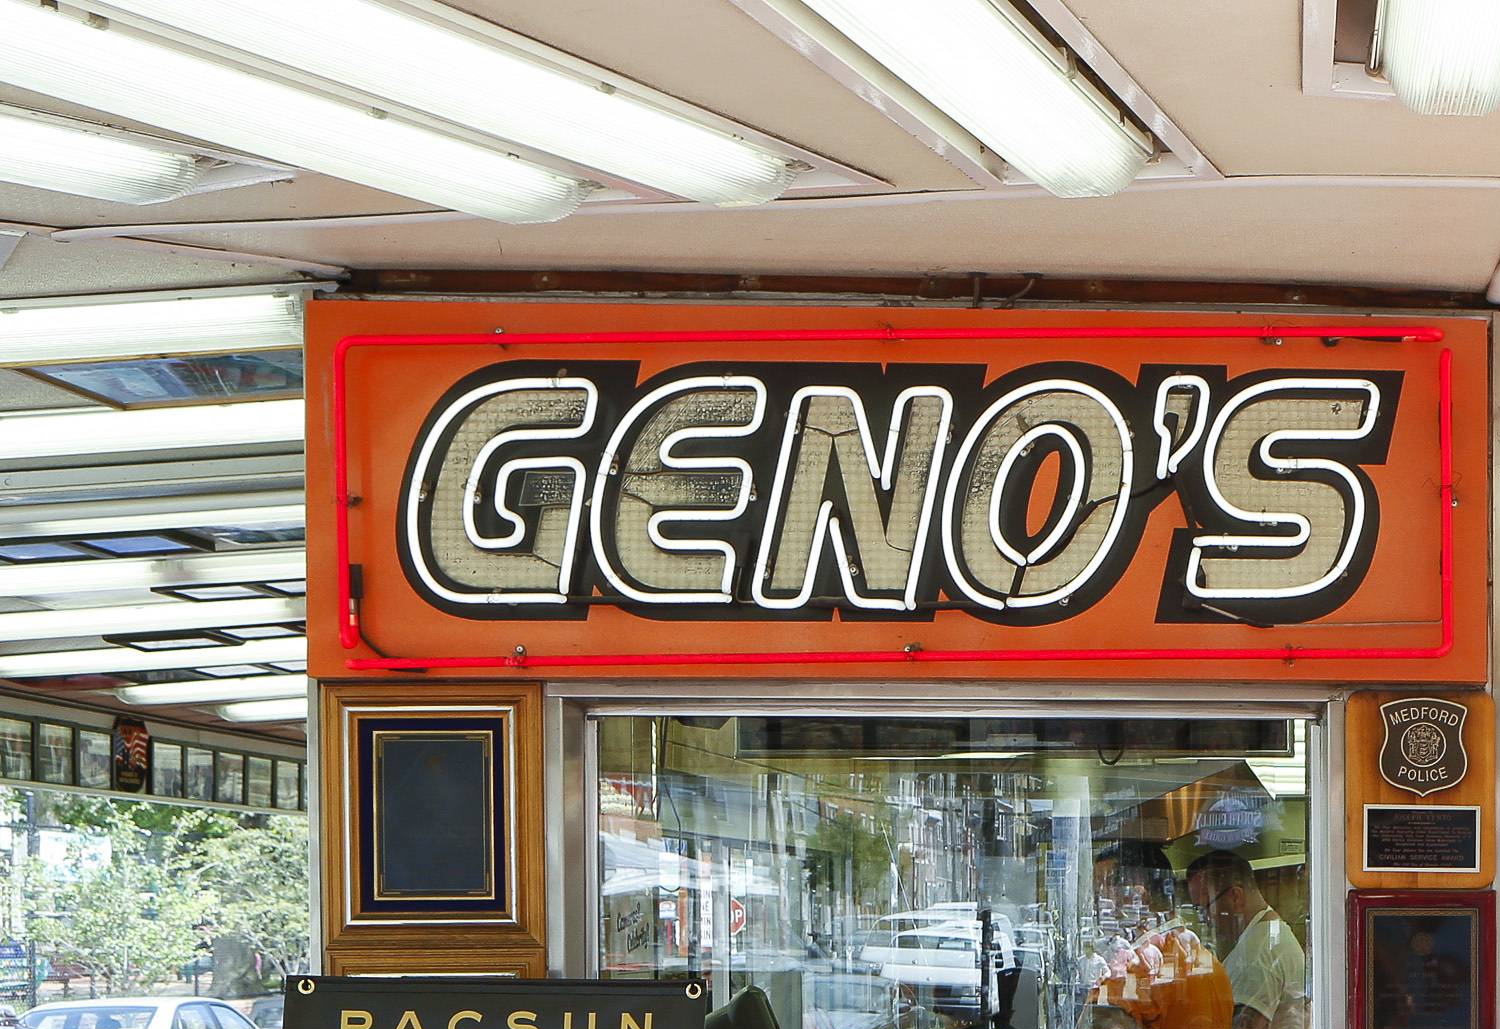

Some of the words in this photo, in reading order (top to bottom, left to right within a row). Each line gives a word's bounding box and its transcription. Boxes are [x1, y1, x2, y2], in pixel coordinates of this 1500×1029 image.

[402, 366, 1394, 617] GENO'S
[1389, 706, 1459, 727] MEDFORD
[1397, 766, 1448, 782] POLICE
